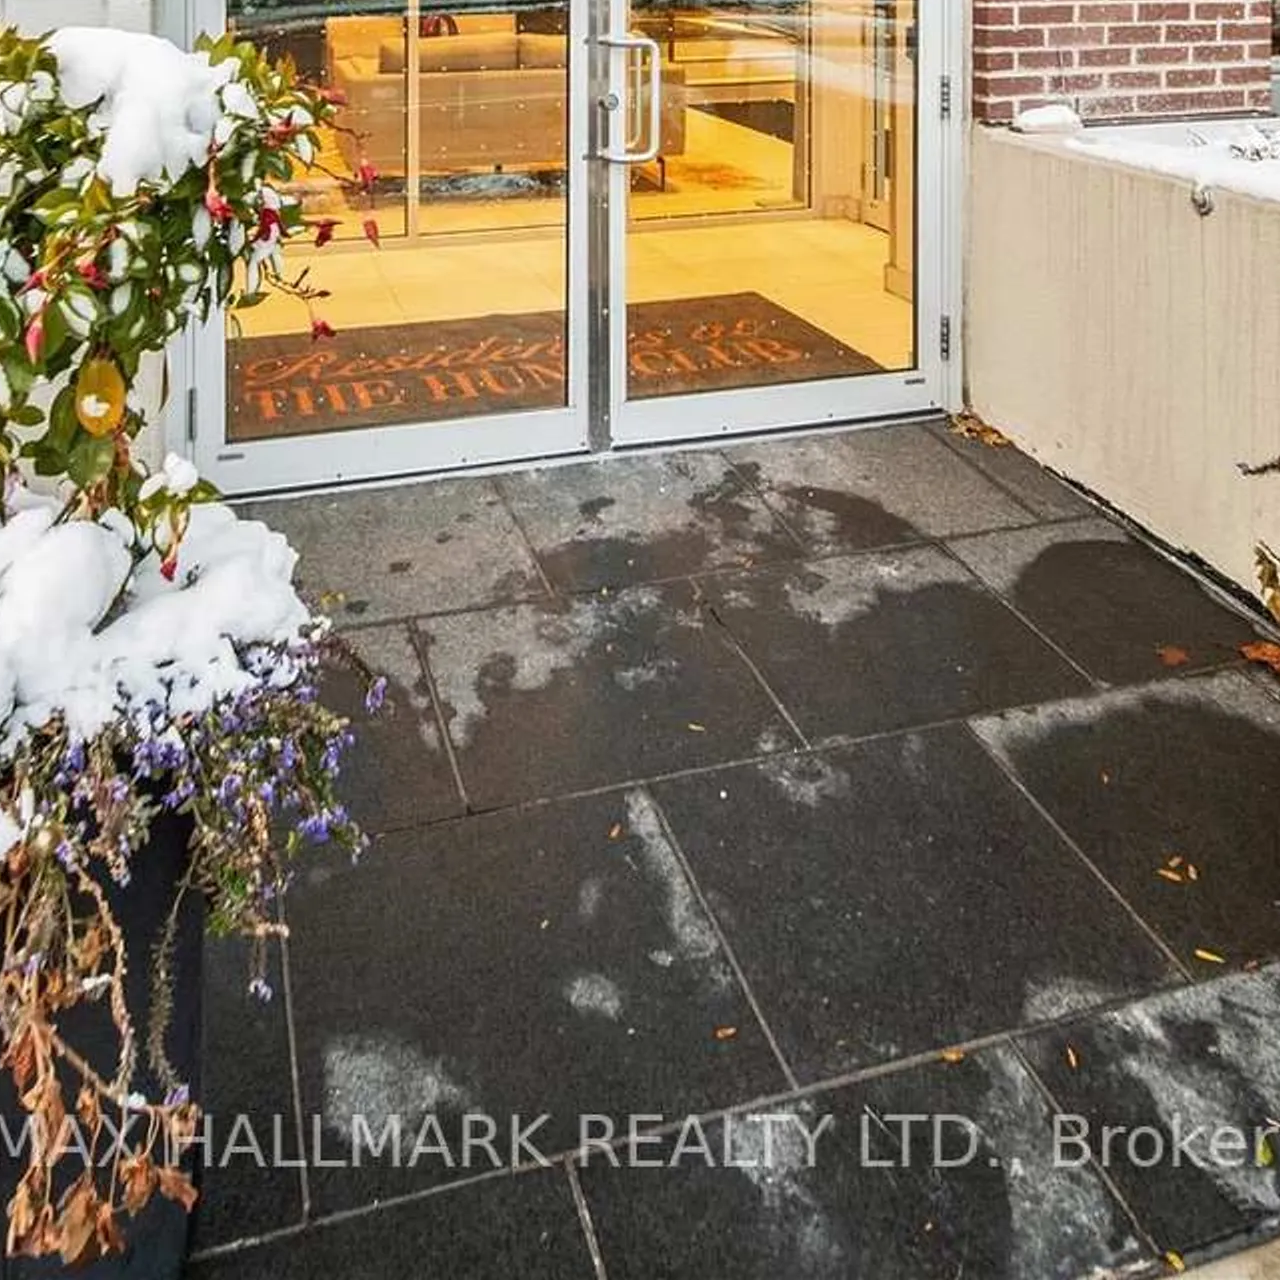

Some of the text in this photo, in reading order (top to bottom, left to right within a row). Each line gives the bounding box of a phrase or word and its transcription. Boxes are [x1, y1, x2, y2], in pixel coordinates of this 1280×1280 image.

[244, 335, 803, 420] THE HUN CLUB
